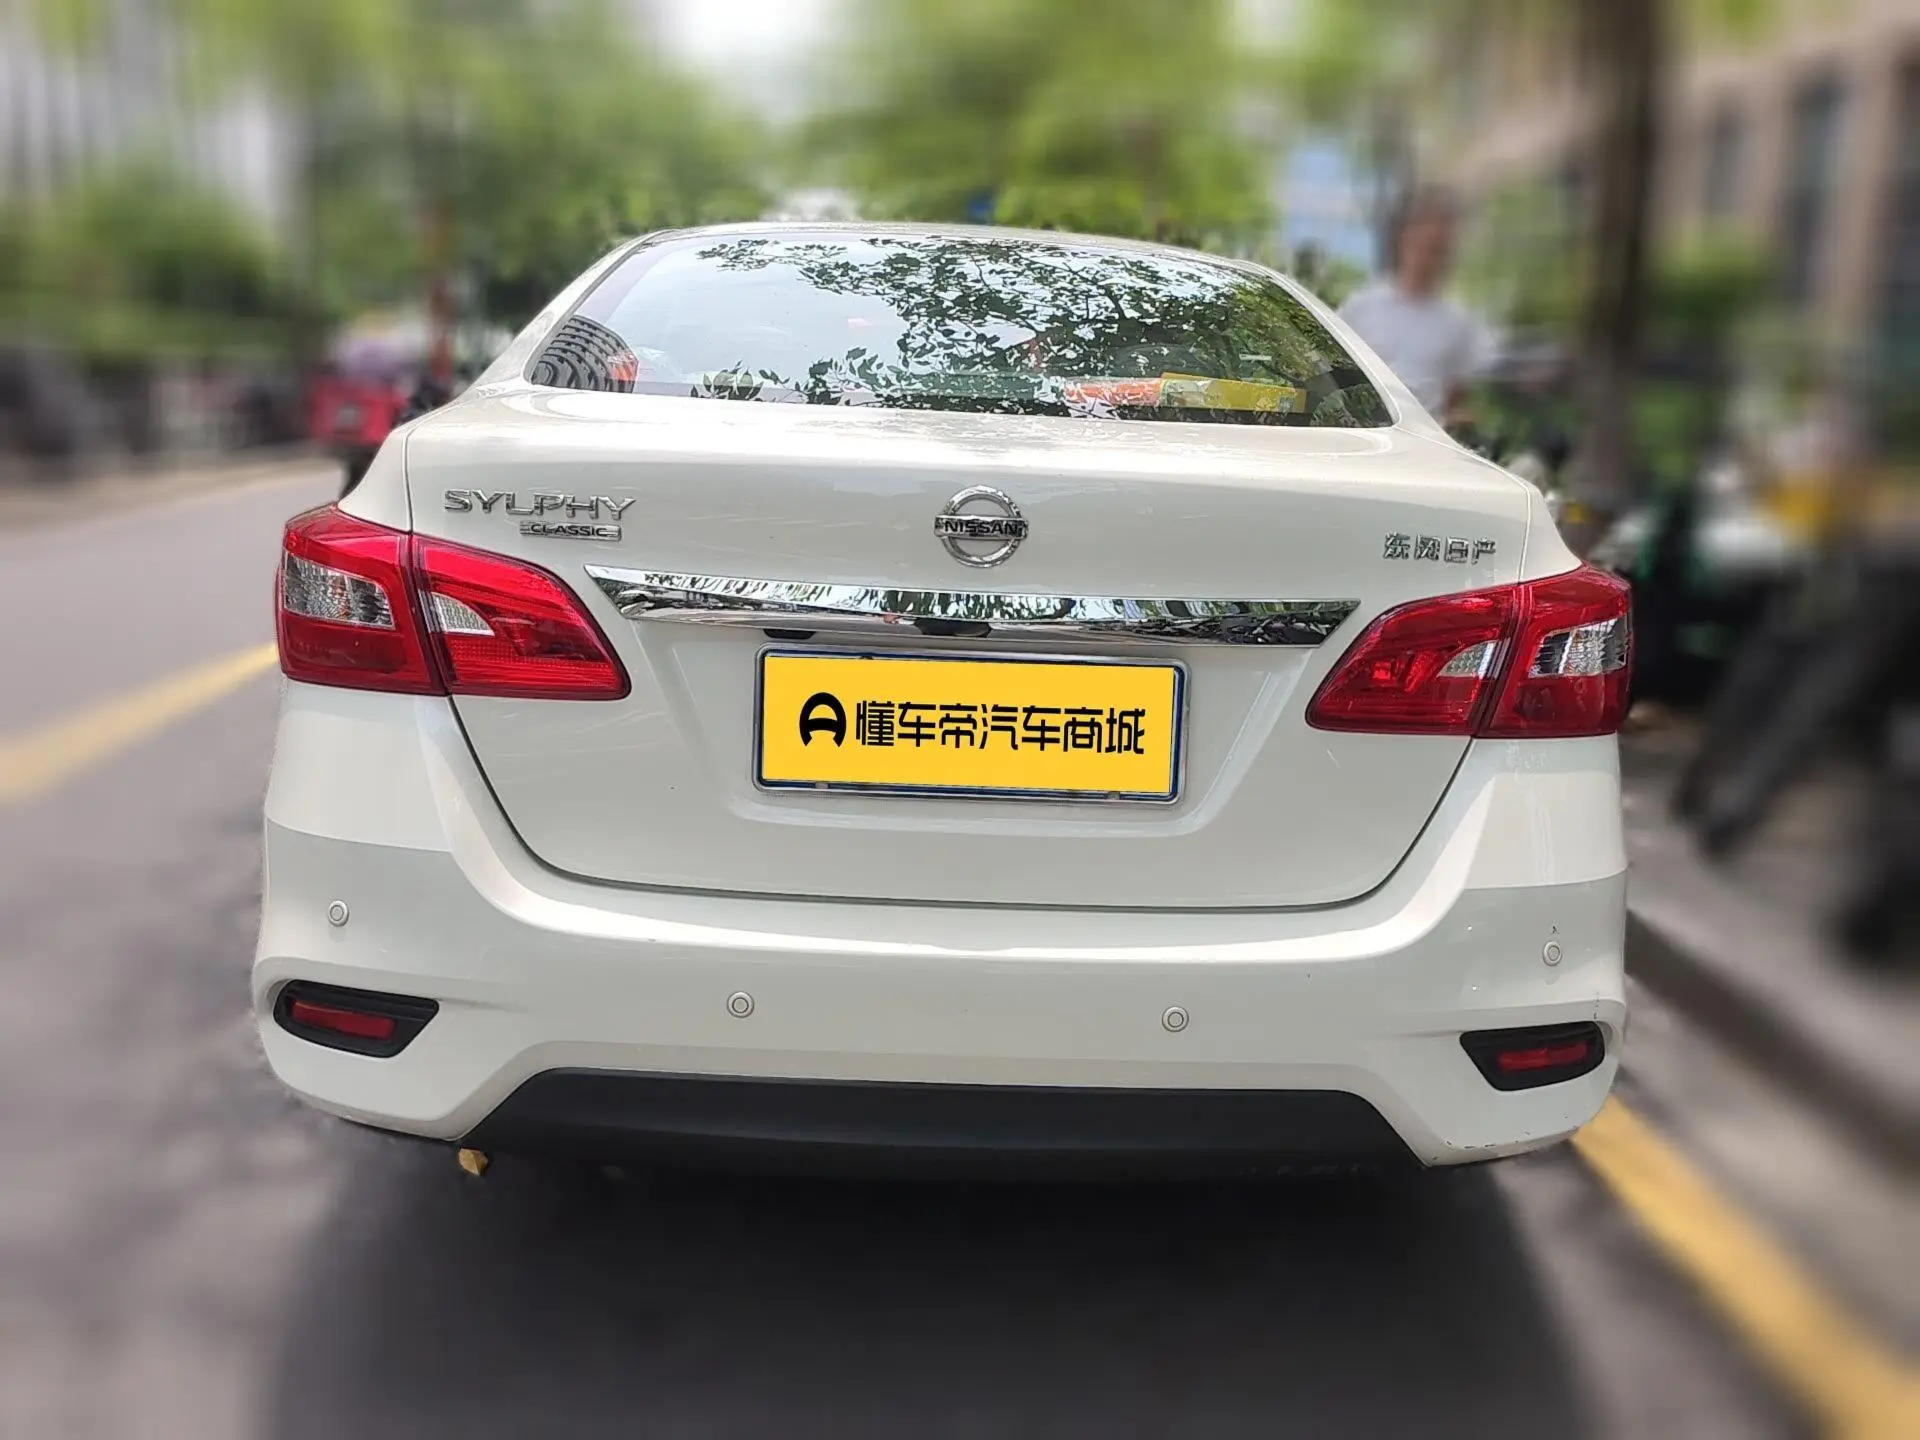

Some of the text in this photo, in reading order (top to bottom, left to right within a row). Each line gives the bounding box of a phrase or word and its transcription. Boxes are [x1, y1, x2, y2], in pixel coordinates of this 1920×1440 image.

[445, 489, 636, 520] SYLPHY
[530, 523, 609, 538] CLASSIC
[944, 519, 1019, 536] NISSAN
[1383, 532, 1496, 564] 东风日产
